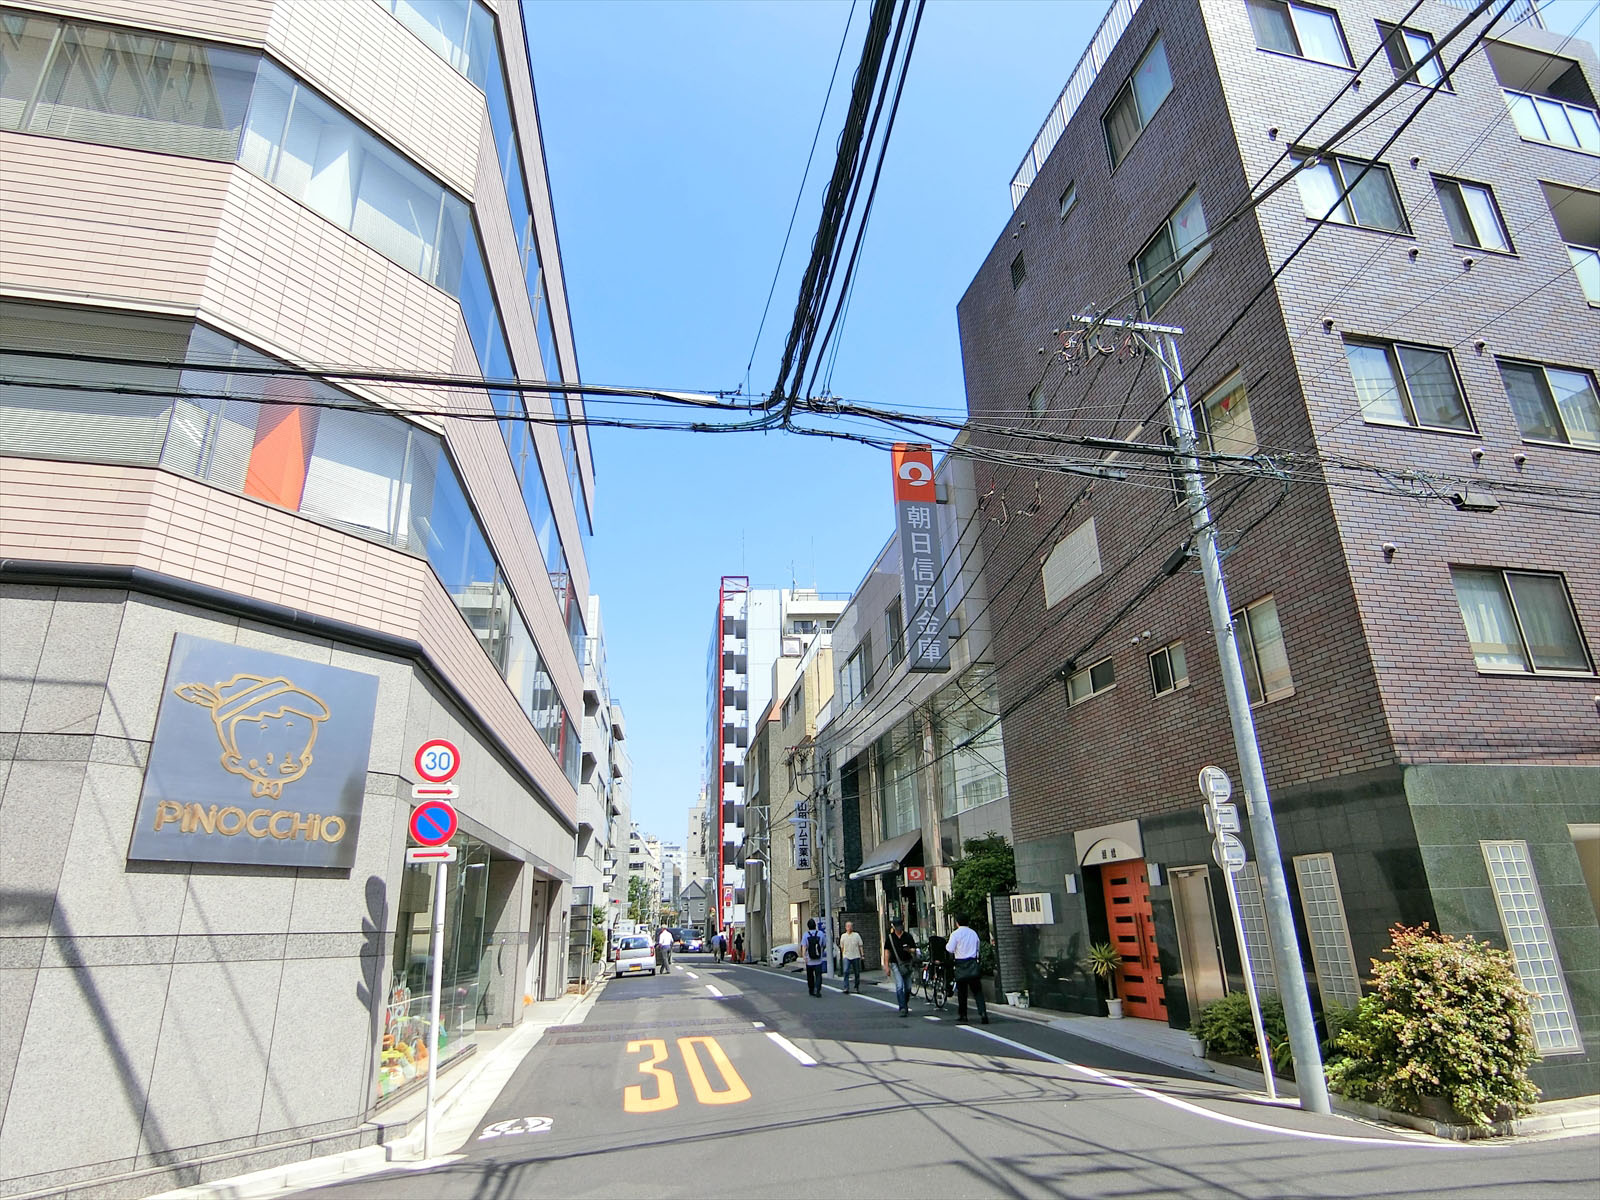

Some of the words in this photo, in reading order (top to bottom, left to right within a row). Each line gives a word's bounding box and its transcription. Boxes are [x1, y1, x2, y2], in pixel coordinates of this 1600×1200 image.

[906, 506, 942, 663] 朝日信用金庫
[425, 752, 450, 771] 30
[624, 1036, 752, 1113] 30
